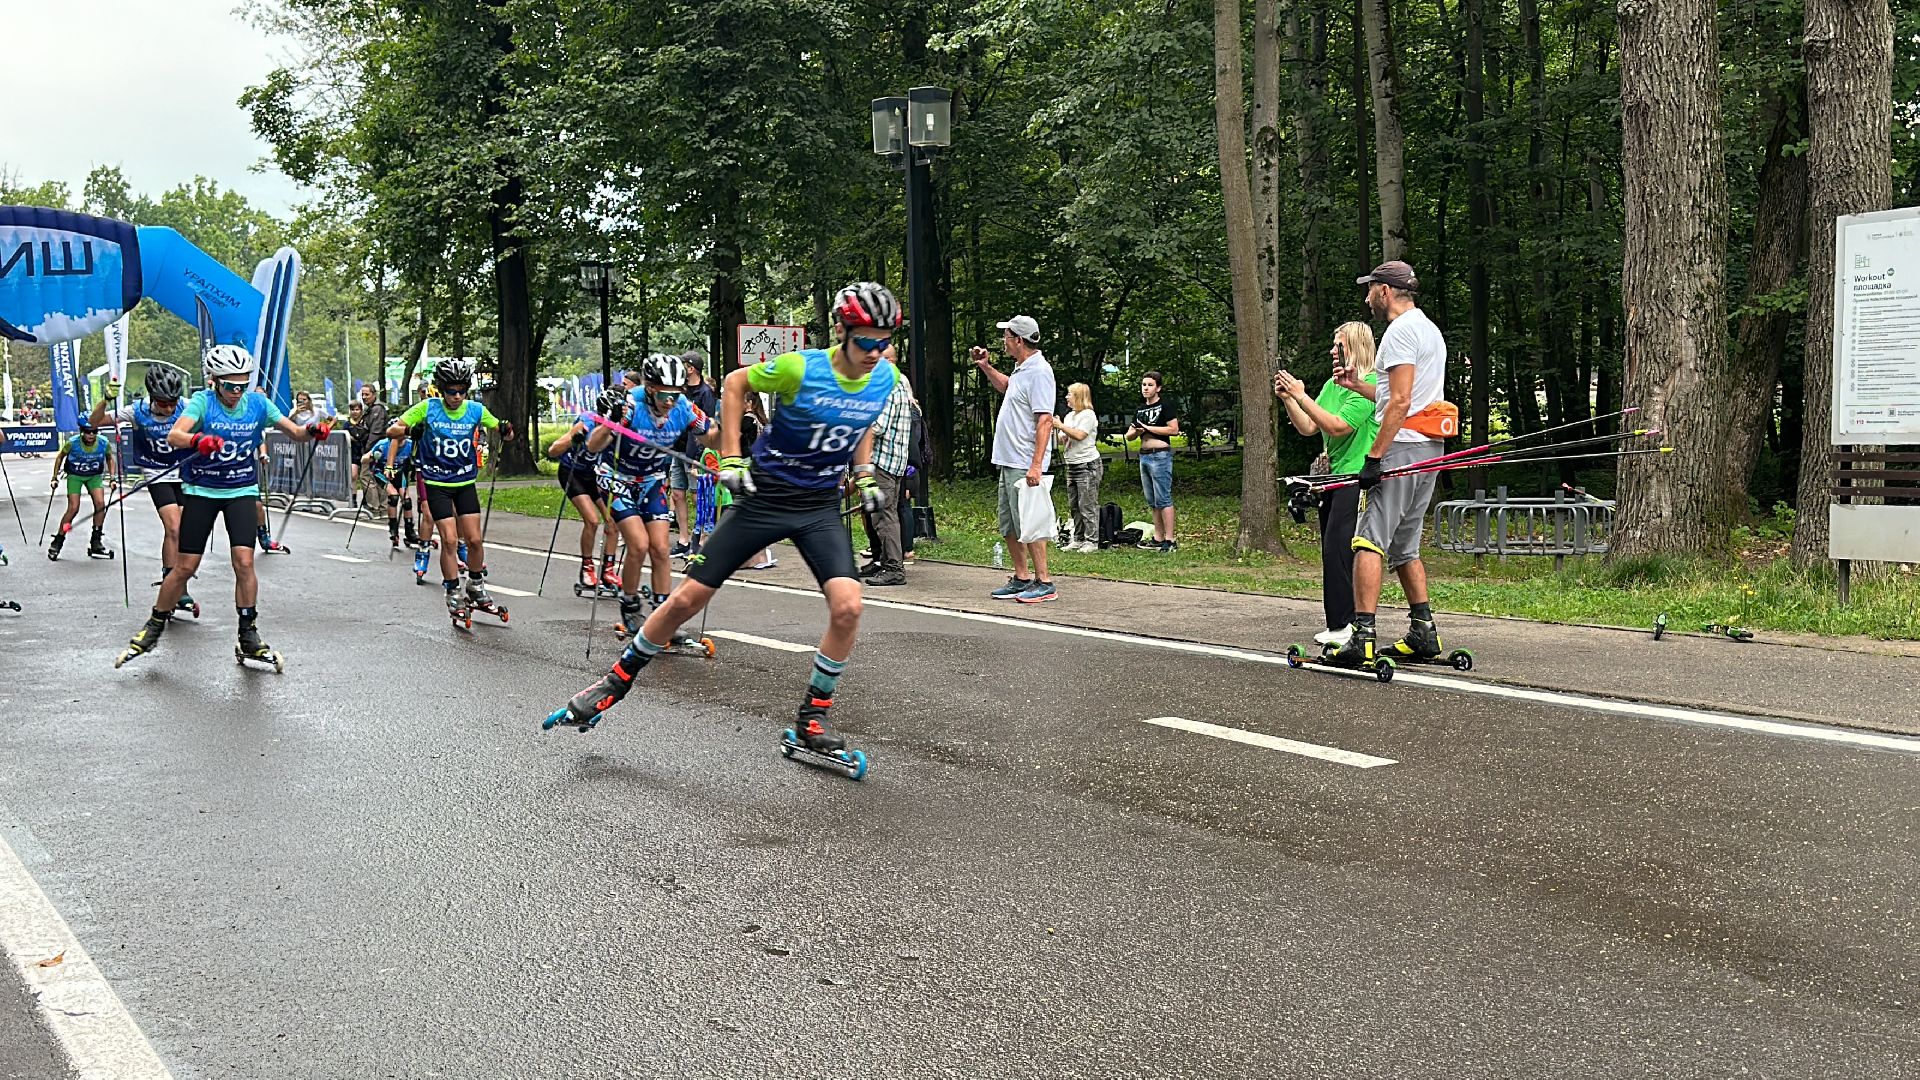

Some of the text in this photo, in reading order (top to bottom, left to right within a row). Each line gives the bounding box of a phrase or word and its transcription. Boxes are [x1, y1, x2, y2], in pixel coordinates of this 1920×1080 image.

[1854, 273, 1885, 282] Workout
[184, 267, 241, 308] УРАЛХИМ
[1853, 282, 1892, 291] площадка
[6, 432, 52, 440] УРАЛХИМ
[808, 423, 868, 452] 181
[146, 438, 173, 454] 18
[432, 437, 472, 458] 180
